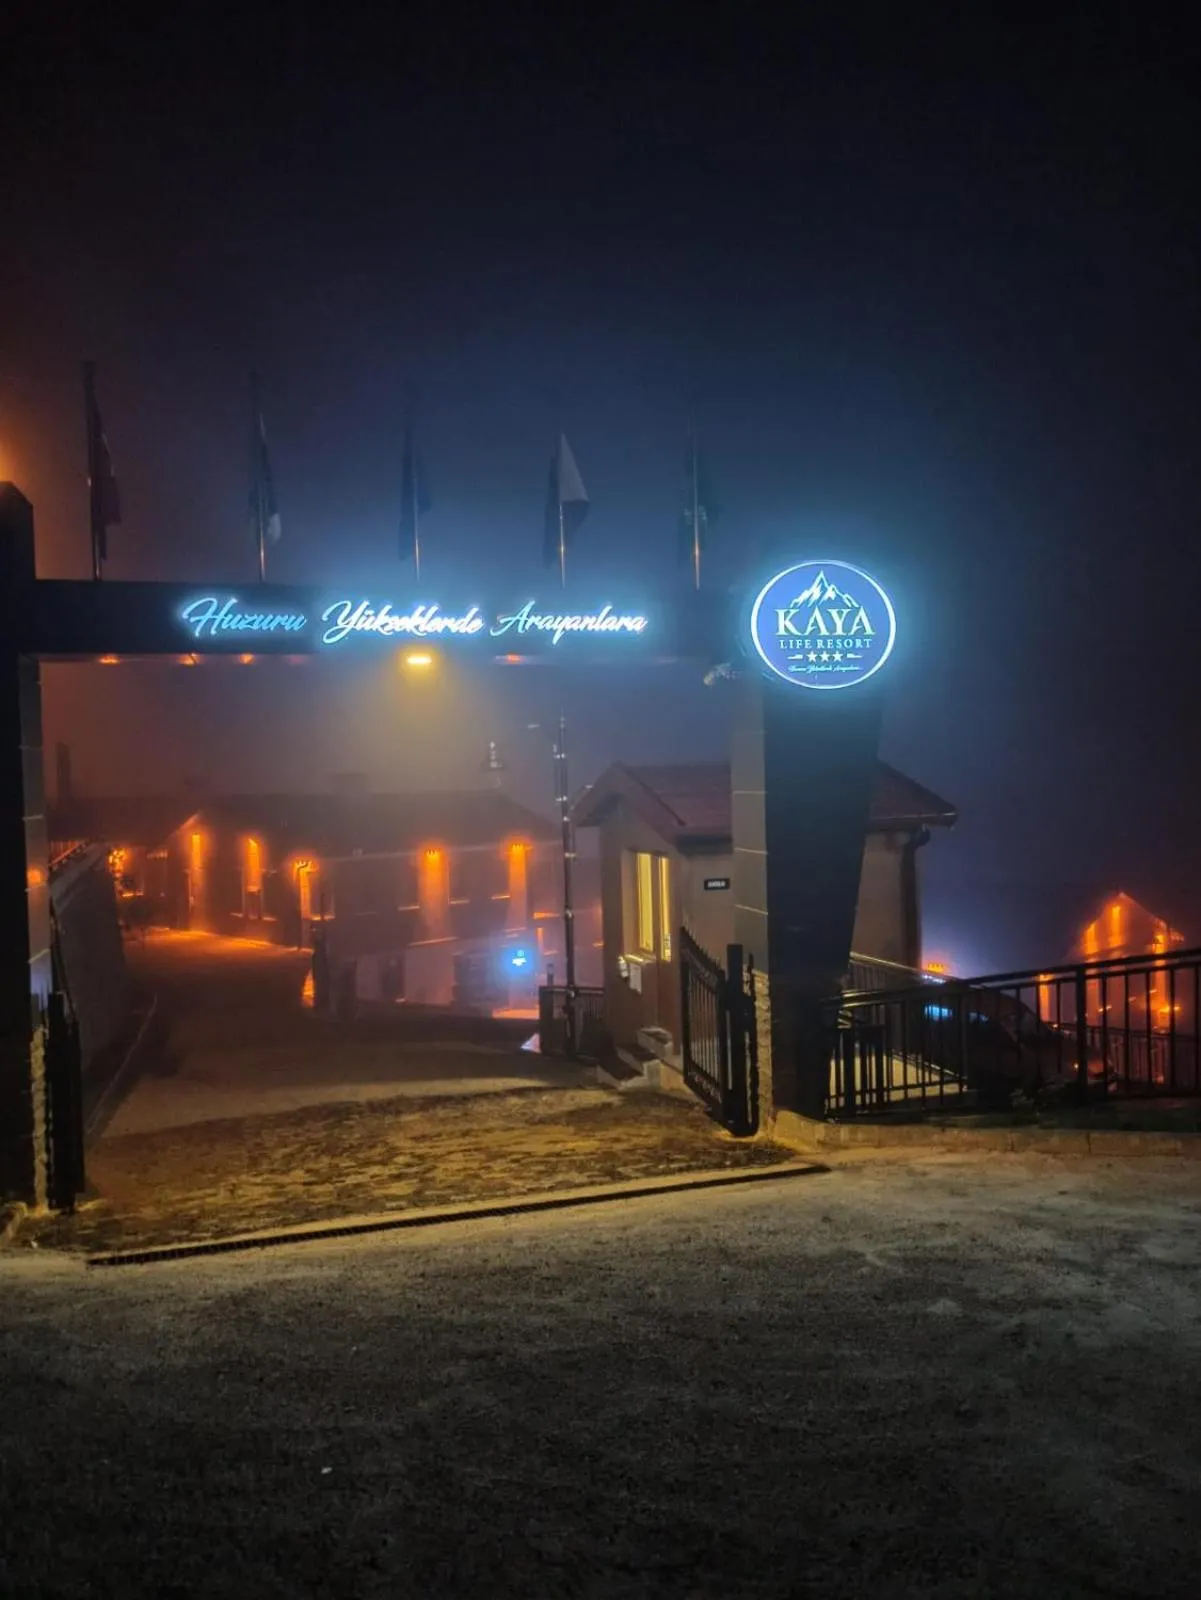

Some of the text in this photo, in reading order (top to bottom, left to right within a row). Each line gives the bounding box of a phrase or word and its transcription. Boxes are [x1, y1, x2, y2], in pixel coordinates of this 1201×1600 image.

[182, 597, 648, 645] Huzuru Yükseklerde Arayanlara
[775, 605, 876, 636] KAYA
[780, 638, 873, 649] LIFE RESORT
